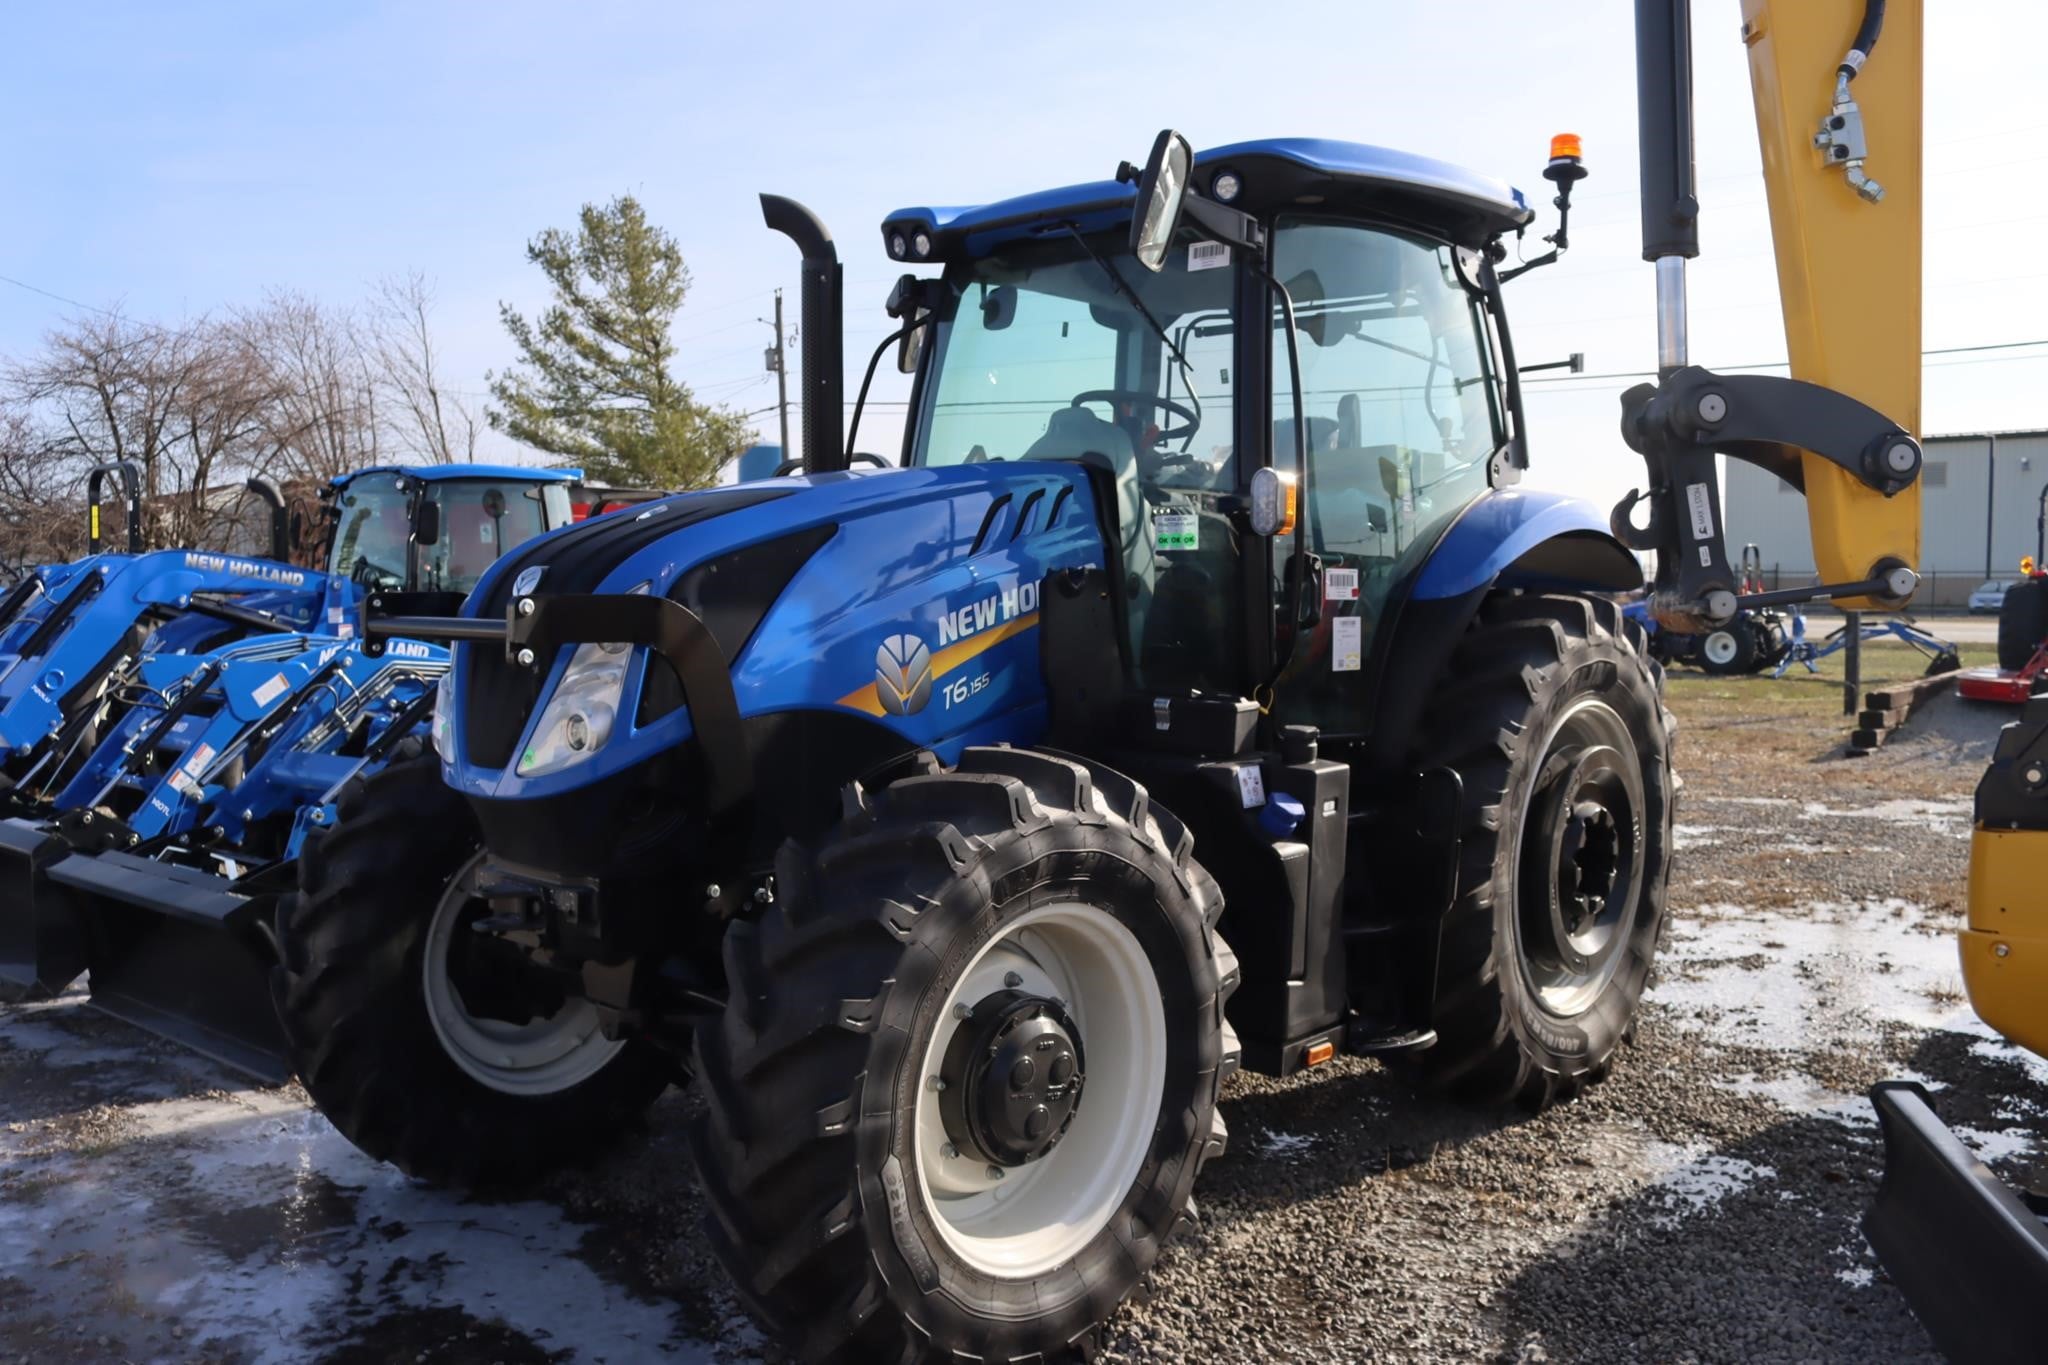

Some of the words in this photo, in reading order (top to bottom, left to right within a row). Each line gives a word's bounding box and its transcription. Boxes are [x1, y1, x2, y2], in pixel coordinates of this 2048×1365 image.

[1158, 536, 1169, 544] OK
[1170, 536, 1181, 544] OK
[1183, 535, 1195, 544] OK
[184, 552, 226, 573] NEW
[228, 560, 305, 587] HOLLAND
[937, 595, 998, 647] NEW
[386, 641, 430, 658] LAND
[942, 671, 990, 711] T6.155
